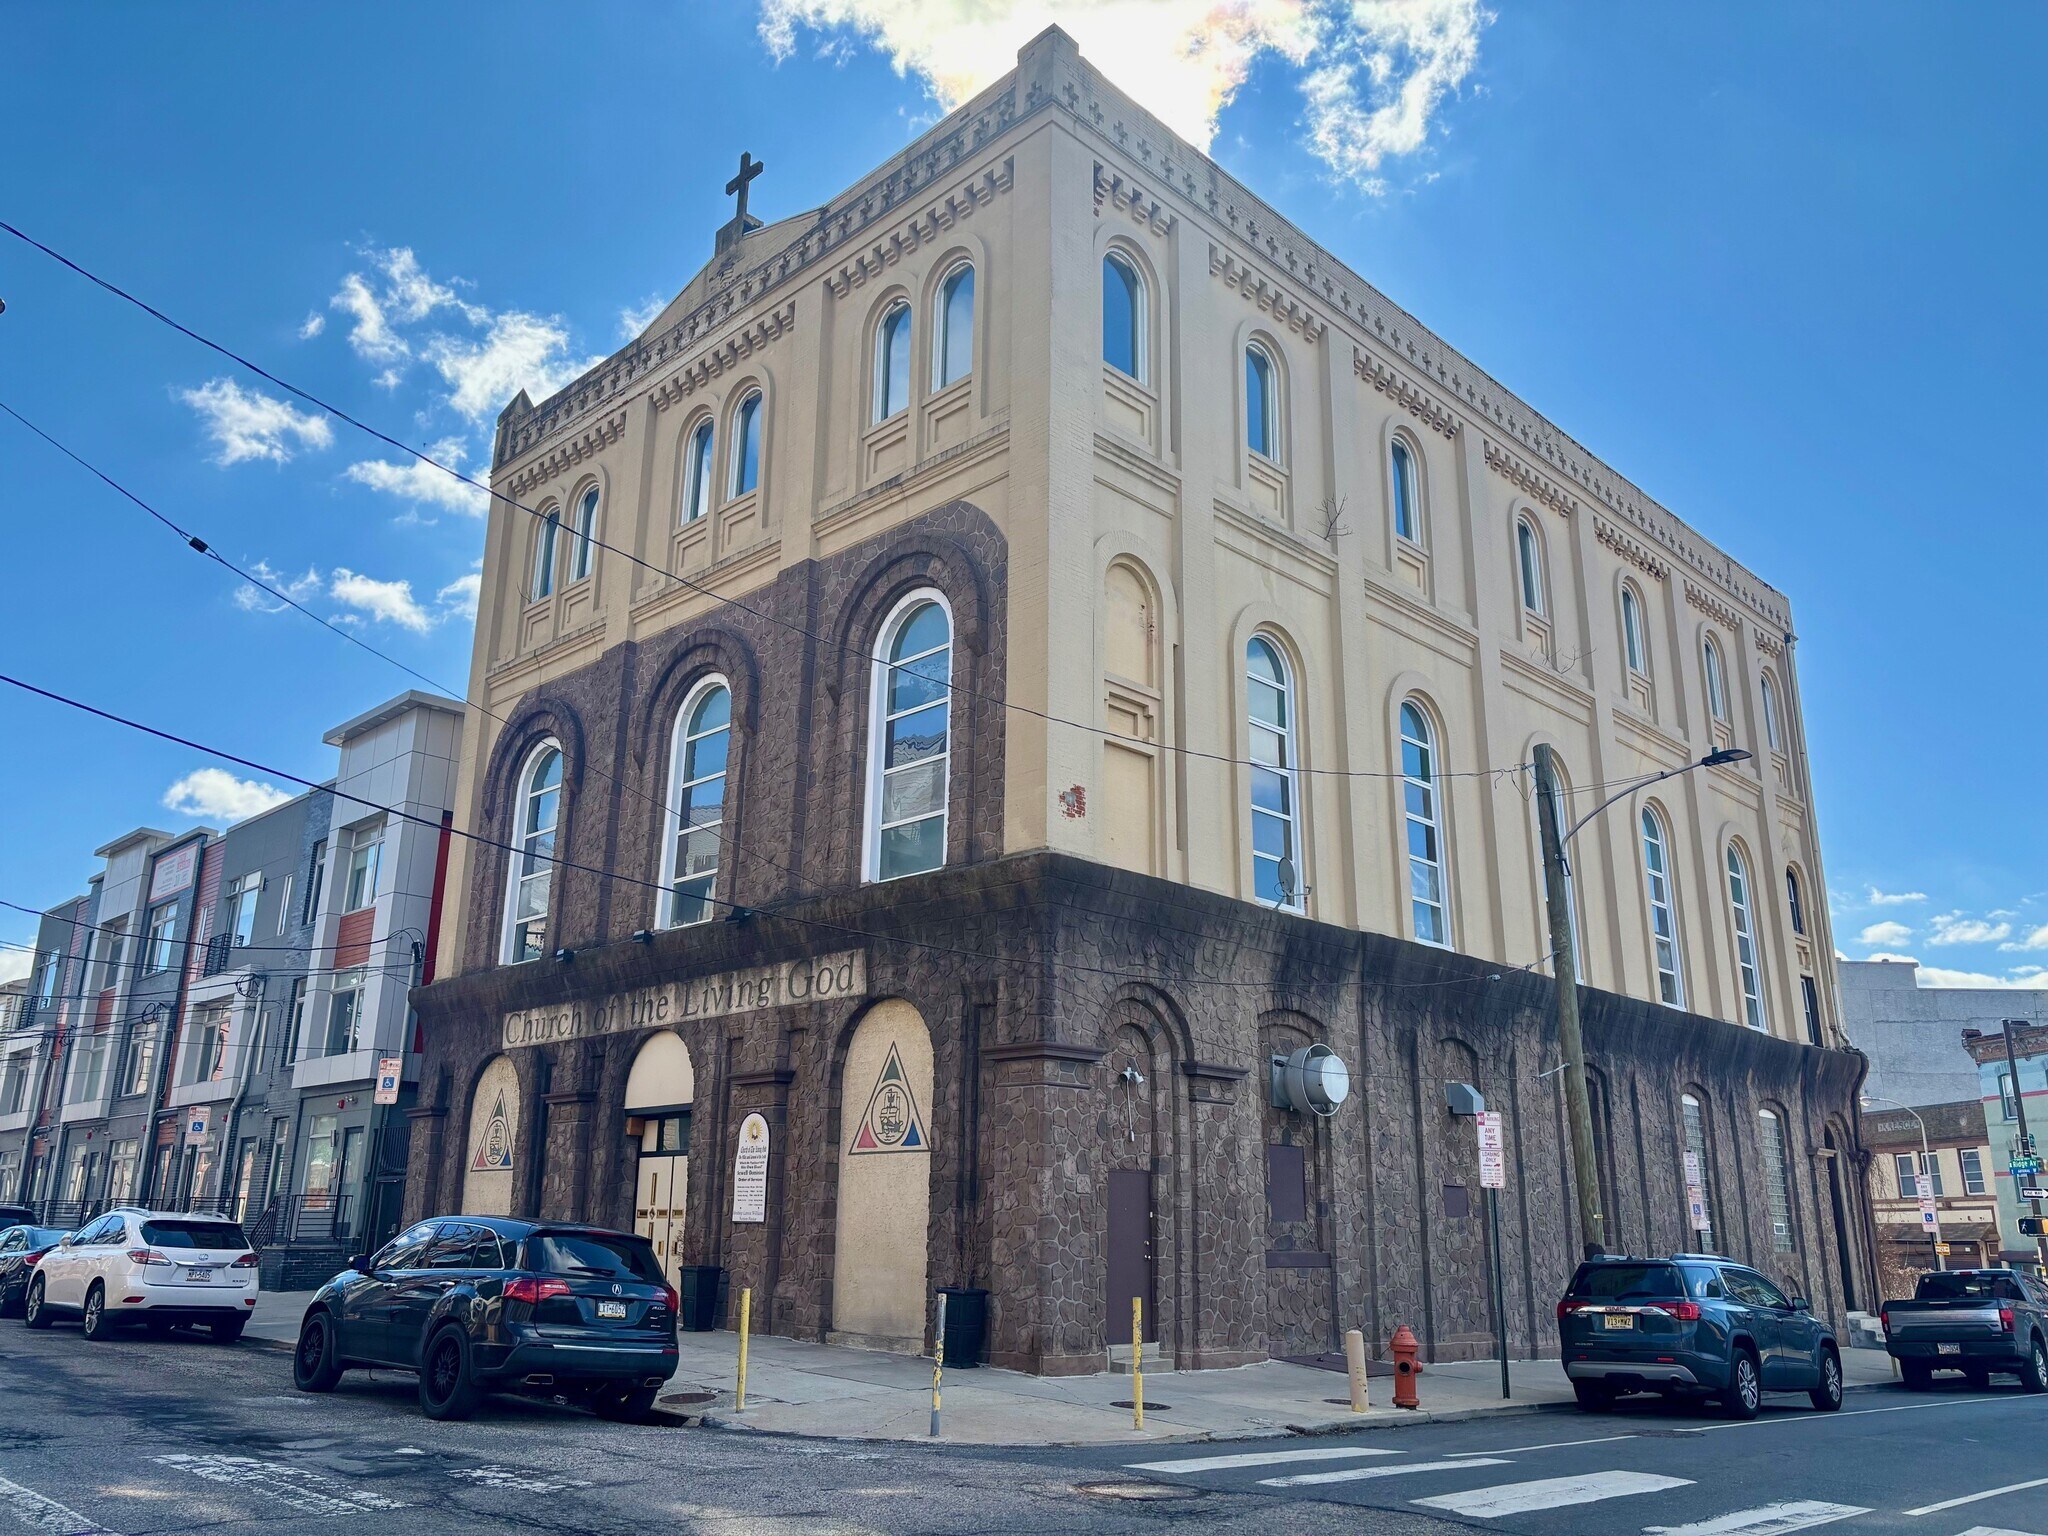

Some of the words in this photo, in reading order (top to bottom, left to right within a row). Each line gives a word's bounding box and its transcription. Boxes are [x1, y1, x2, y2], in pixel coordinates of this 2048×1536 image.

[505, 1002, 582, 1044] Church
[594, 994, 617, 1032] of
[631, 987, 668, 1025] the
[680, 973, 774, 1018] Living
[788, 952, 856, 999] God
[2013, 1161, 2028, 1169] Ridge
